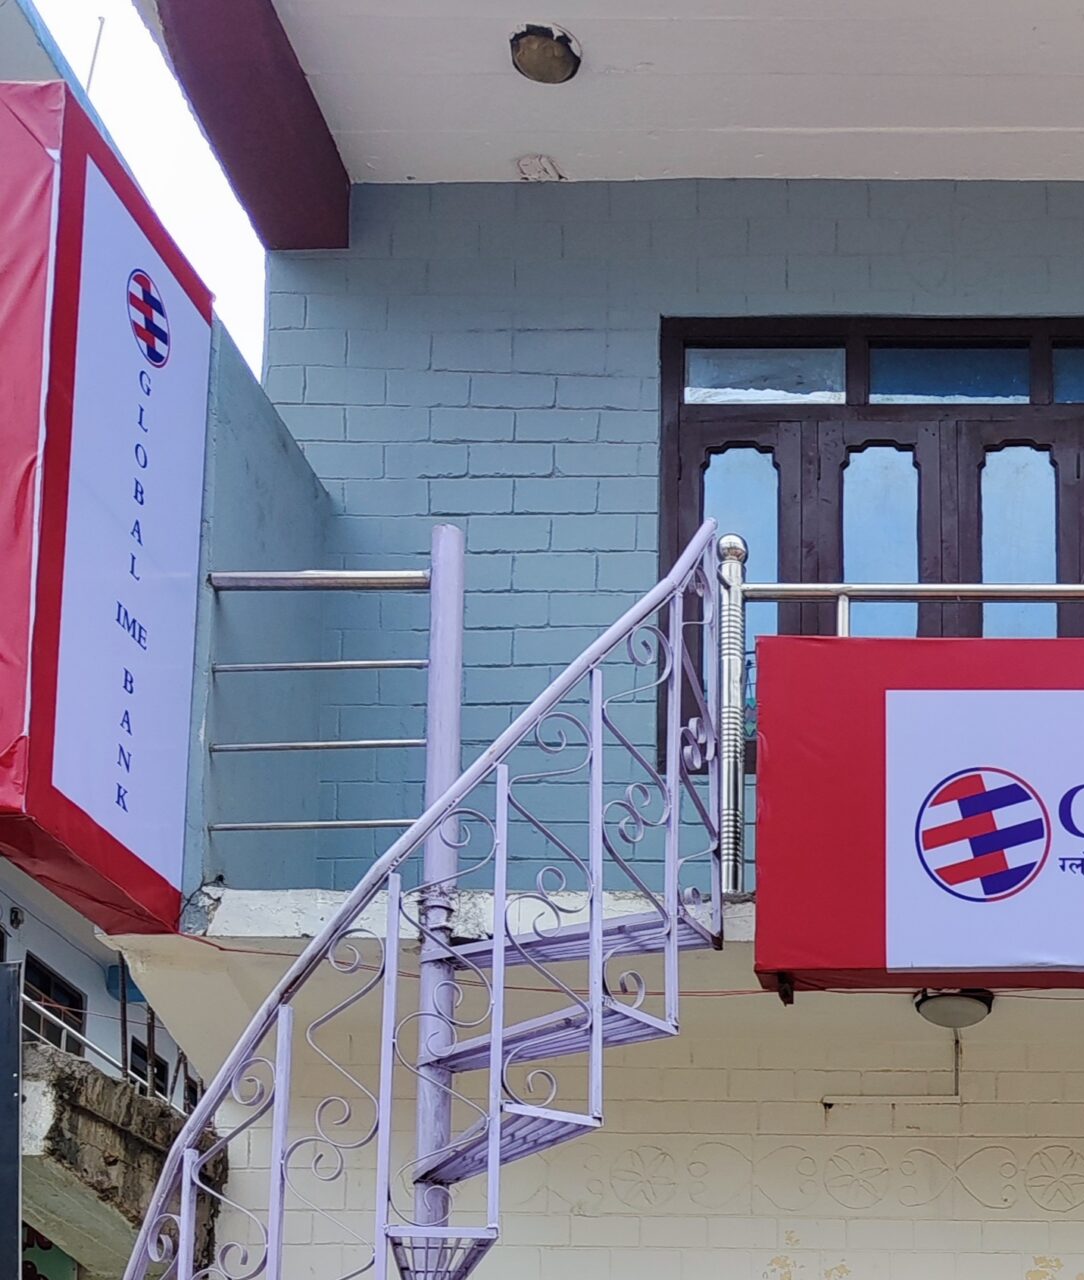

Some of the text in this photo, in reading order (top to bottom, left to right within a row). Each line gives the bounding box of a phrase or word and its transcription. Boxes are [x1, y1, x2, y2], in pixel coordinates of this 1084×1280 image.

[115, 370, 151, 813] GLOBAL IME BANK
